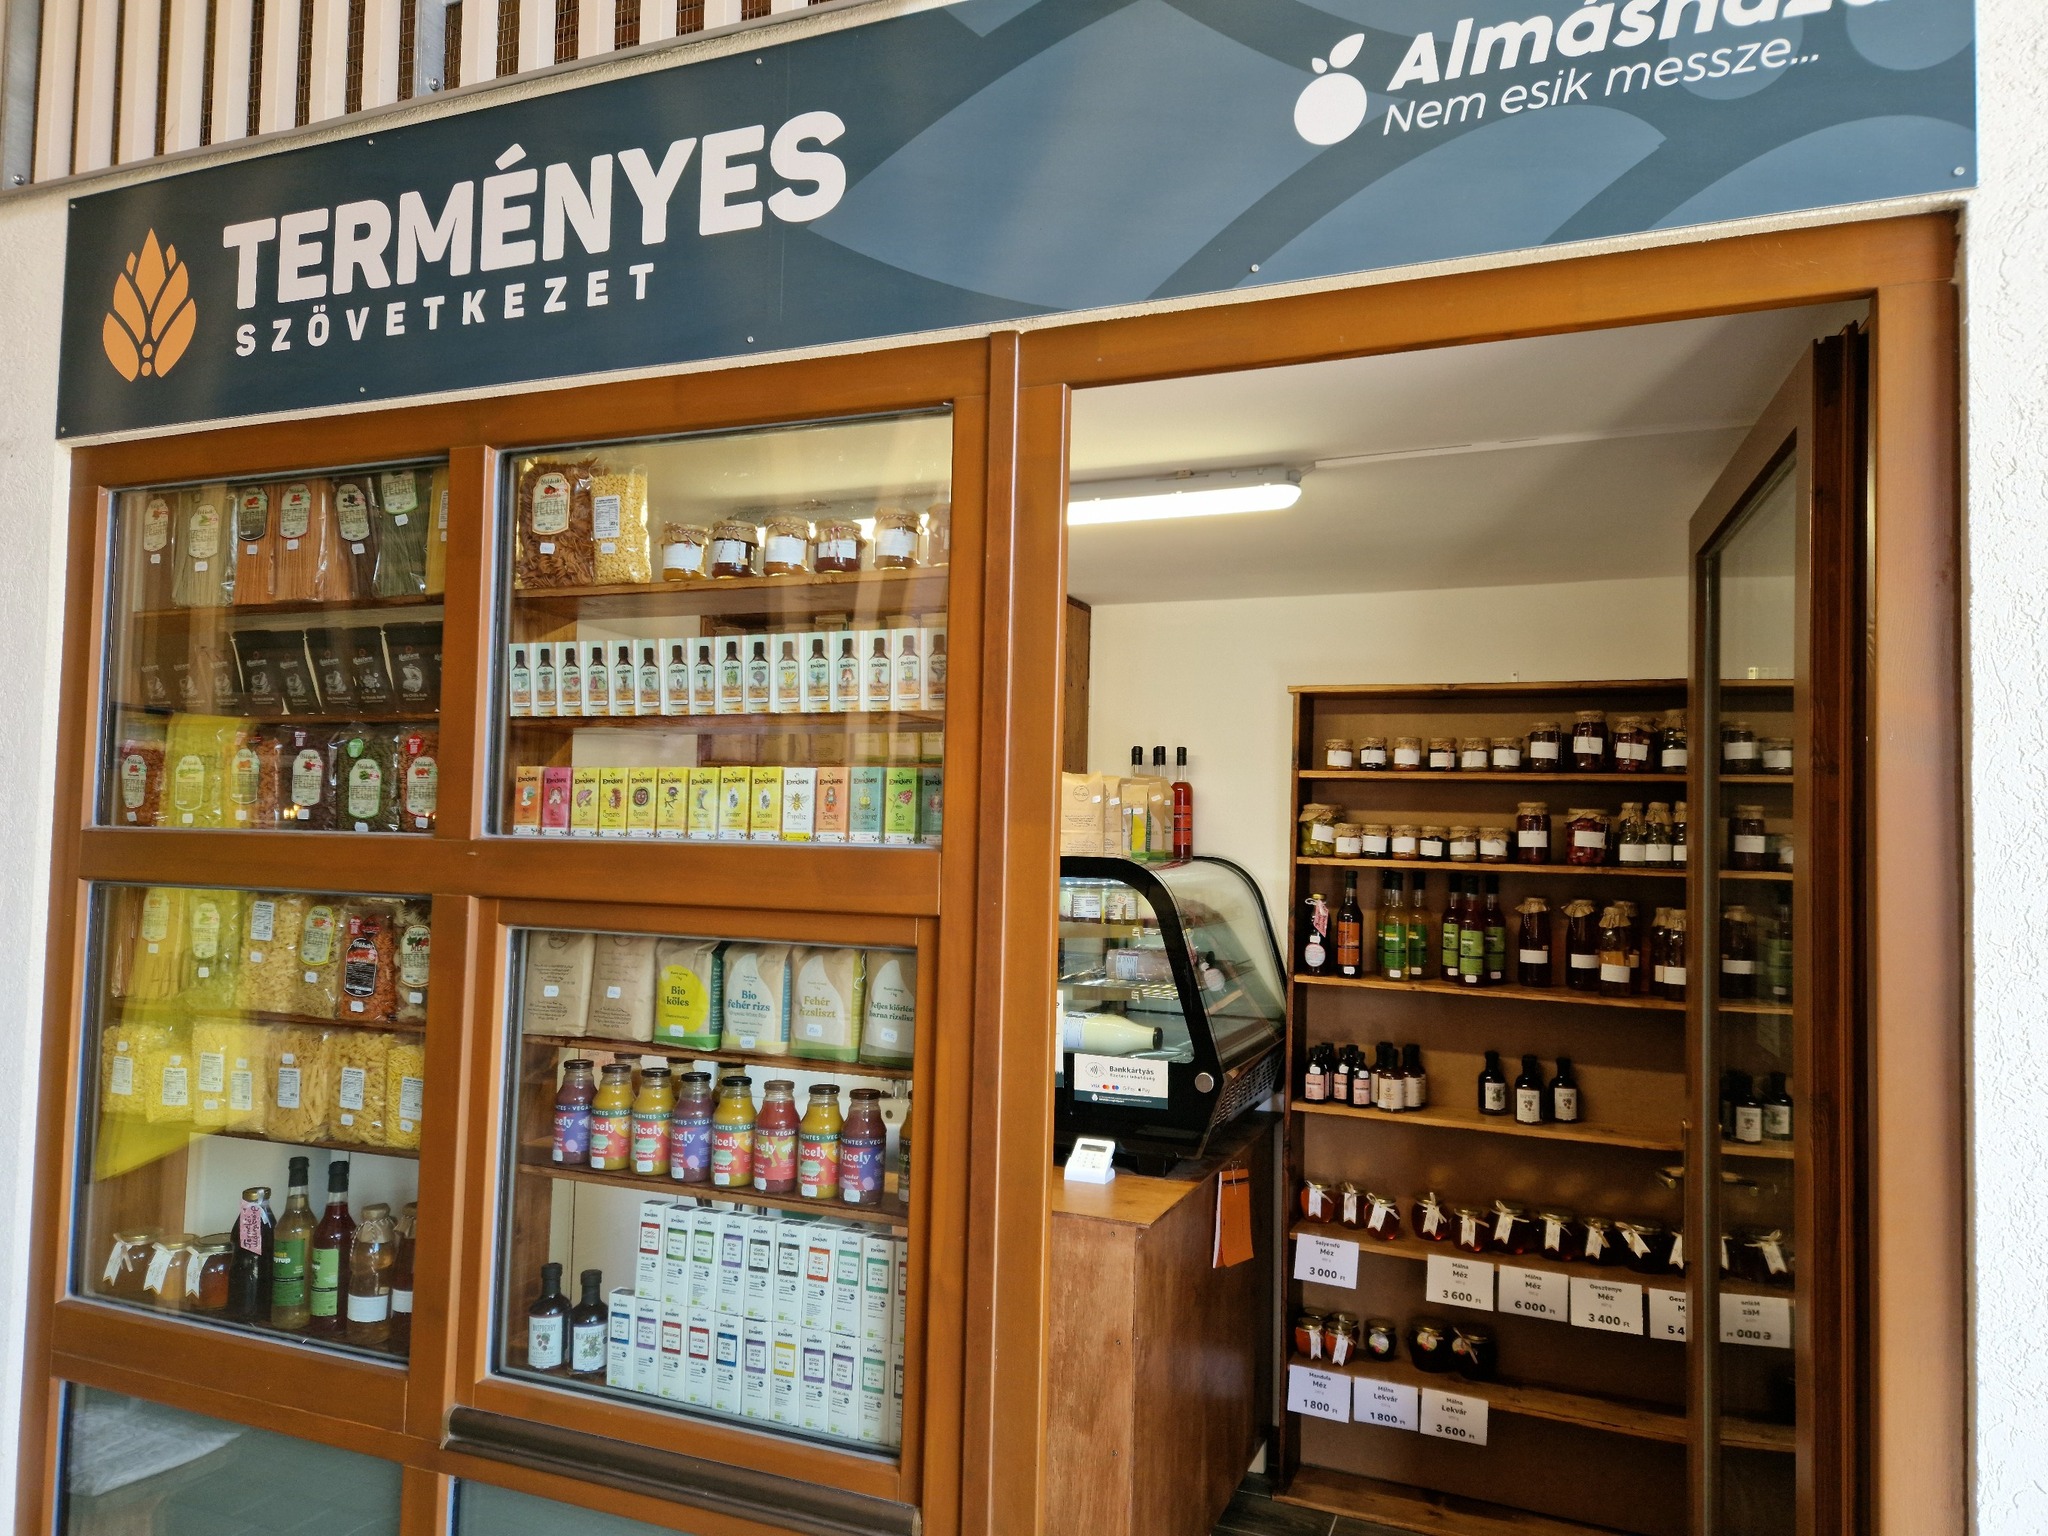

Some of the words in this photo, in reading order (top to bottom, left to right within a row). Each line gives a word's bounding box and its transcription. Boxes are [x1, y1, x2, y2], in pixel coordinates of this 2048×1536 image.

[1383, 91, 1487, 136] Nem
[1500, 66, 1592, 115] esik
[222, 110, 847, 311] TERMÉNYES
[235, 263, 655, 358] SZÖVETKEZET
[670, 986, 686, 996] Bio
[742, 990, 757, 1000] Bio
[727, 999, 751, 1010] fehér
[752, 1002, 770, 1012] rizs
[804, 996, 830, 1006] Fehér
[889, 1013, 914, 1021] rizslisz
[1109, 1066, 1154, 1075] Bankkártyás
[554, 1116, 574, 1128] cely
[1320, 1248, 1334, 1256] Méz
[1309, 1267, 1316, 1275] 3
[1317, 1269, 1337, 1279] 000
[1452, 1270, 1468, 1279] Méz
[1525, 1281, 1541, 1290] Méz
[1443, 1290, 1449, 1298] 3
[1451, 1292, 1472, 1302] 600
[1598, 1292, 1614, 1301] Méz
[1514, 1300, 1522, 1309] 6
[1524, 1302, 1546, 1313] 000
[1588, 1313, 1595, 1322] 3
[1598, 1314, 1621, 1326] 400
[1668, 1326, 1675, 1334] 5
[1312, 1380, 1327, 1389] Méz
[1373, 1393, 1398, 1403] Lekvár
[1303, 1399, 1308, 1408] 1
[1310, 1400, 1330, 1412] 800
[1441, 1405, 1467, 1416] Lekvár
[1377, 1413, 1398, 1424] 800
[1436, 1424, 1442, 1433] 3
[1444, 1426, 1466, 1438] 600
